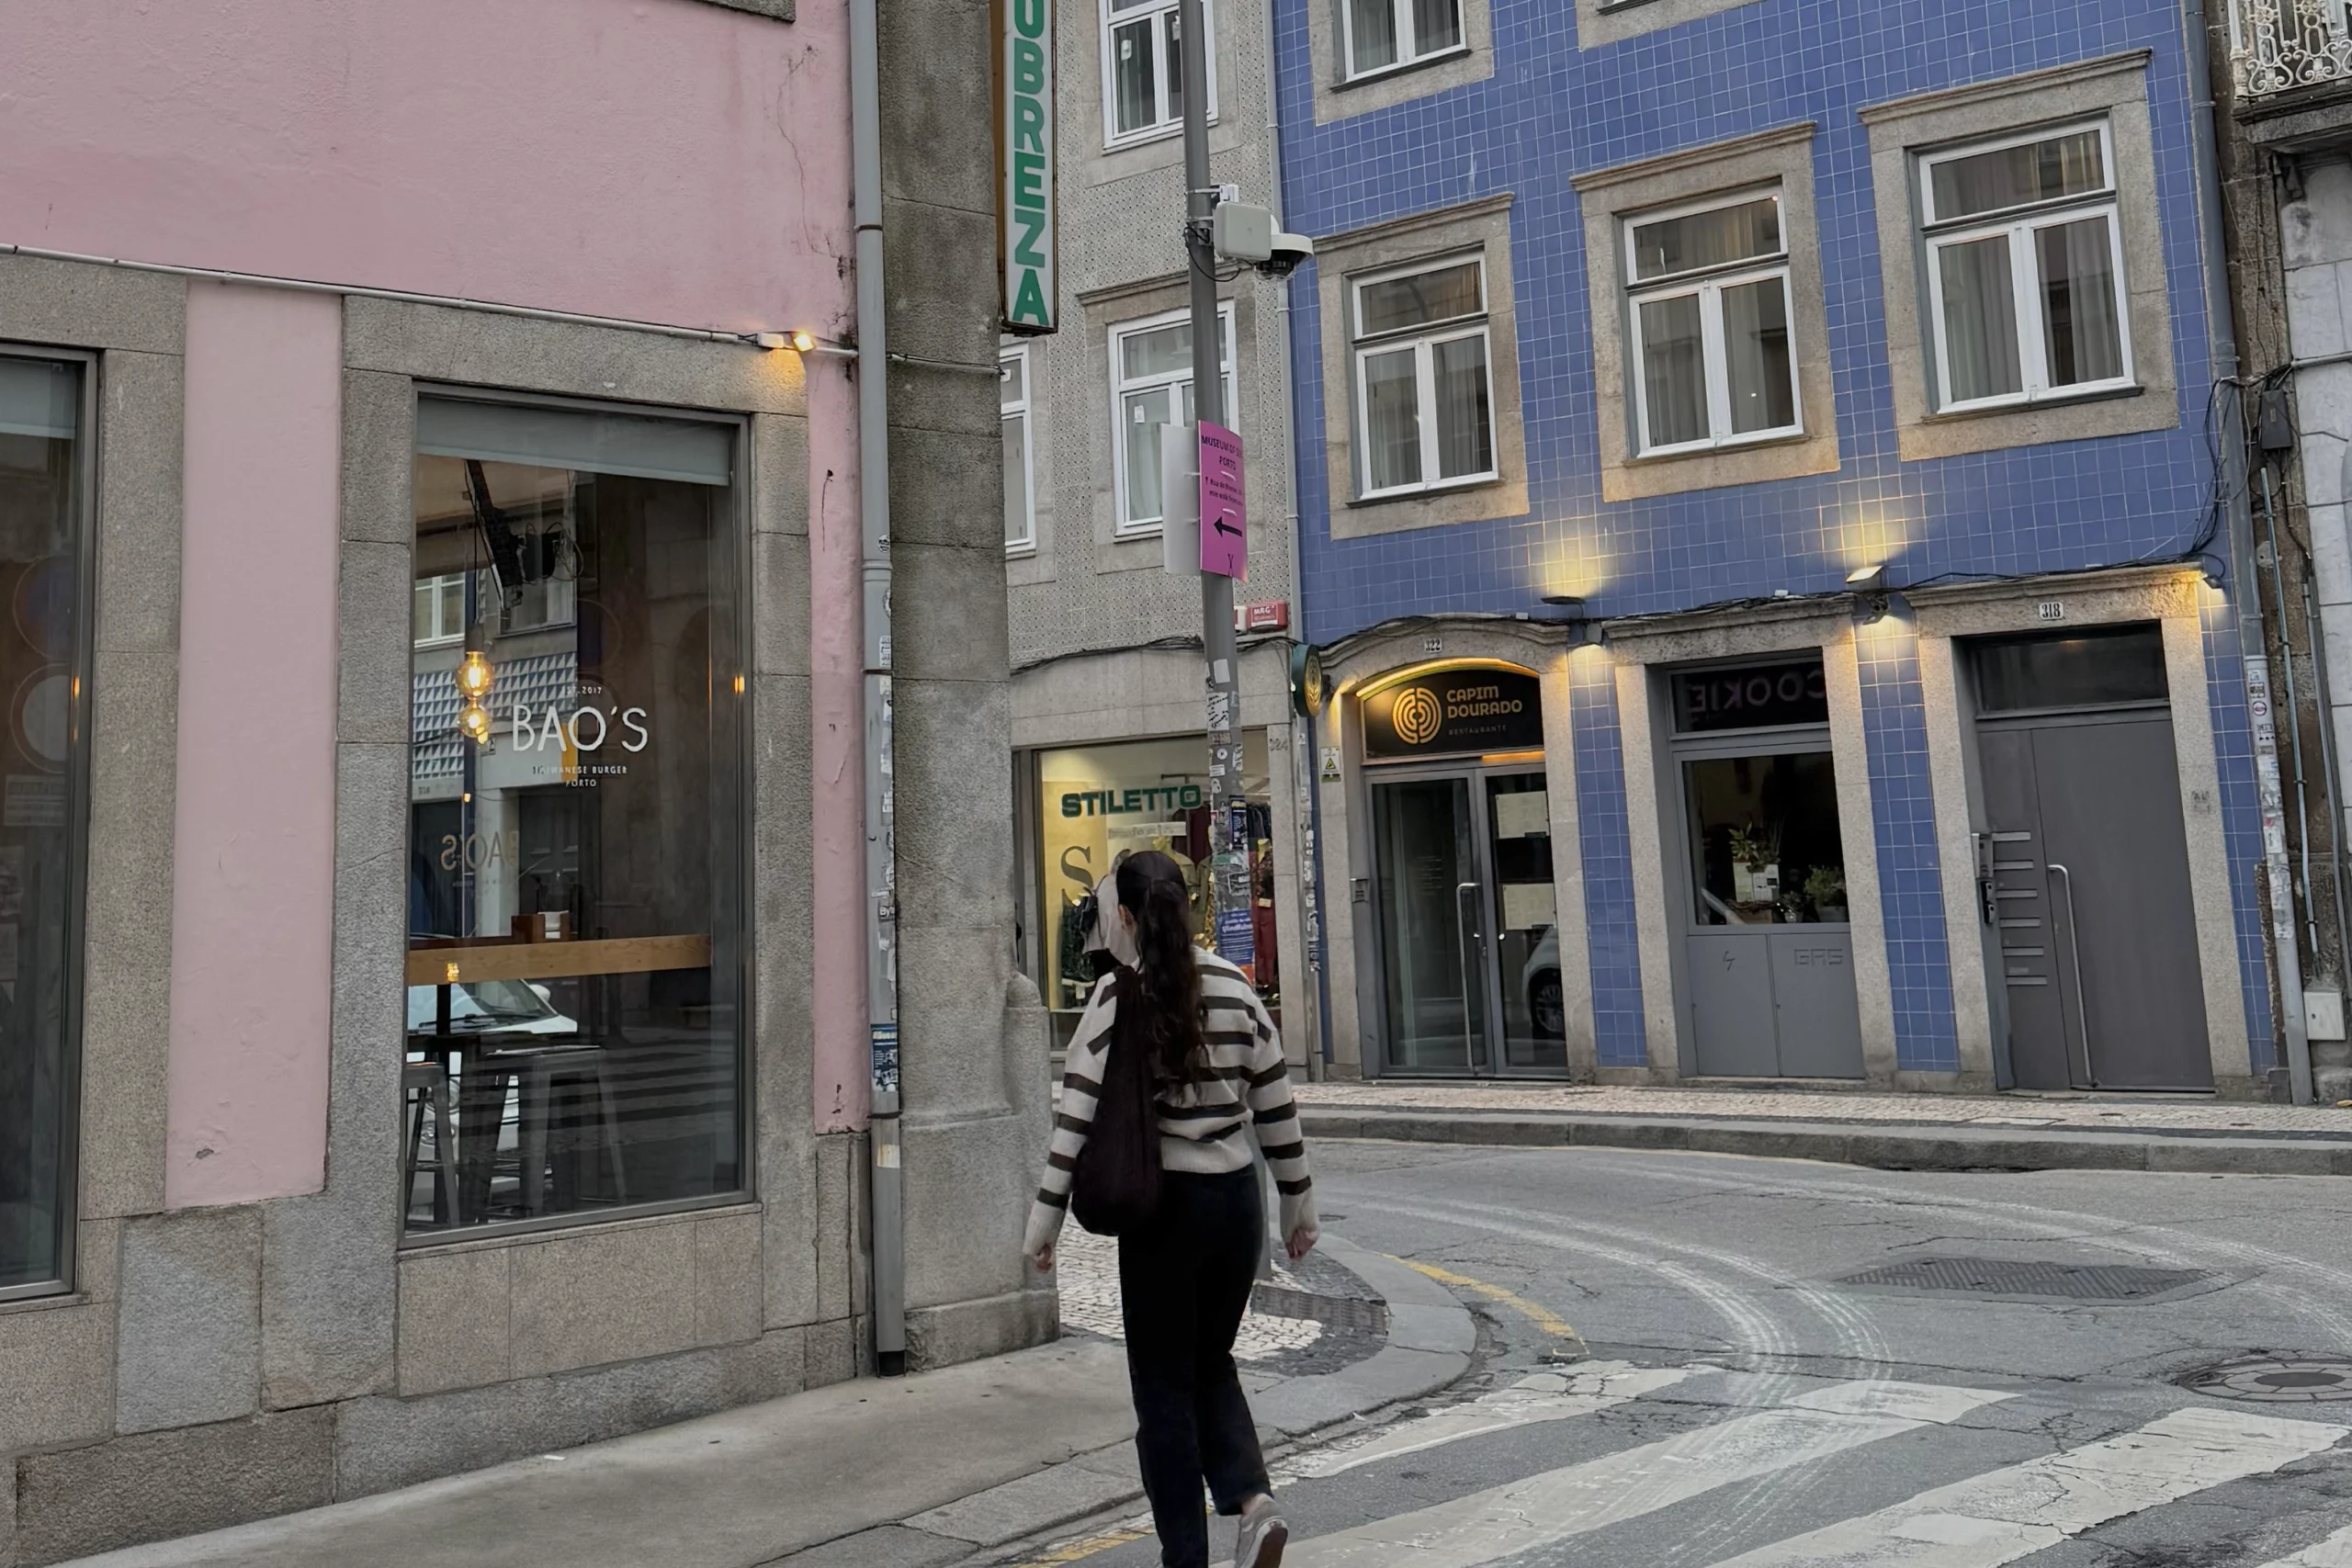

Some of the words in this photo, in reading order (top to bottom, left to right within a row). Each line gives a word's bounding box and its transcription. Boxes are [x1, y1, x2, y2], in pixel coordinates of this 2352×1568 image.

[1202, 435, 1229, 452] MUSEUM
[2041, 603, 2061, 618] 318
[1446, 685, 1499, 703] CAPIM
[1447, 699, 1522, 719] DOURADO
[513, 705, 648, 752] BAO'S
[1448, 724, 1507, 736] RESTAURANTE
[593, 765, 628, 774] BURGER
[565, 779, 597, 787] PORTO
[1061, 784, 1202, 818] STILETTO
